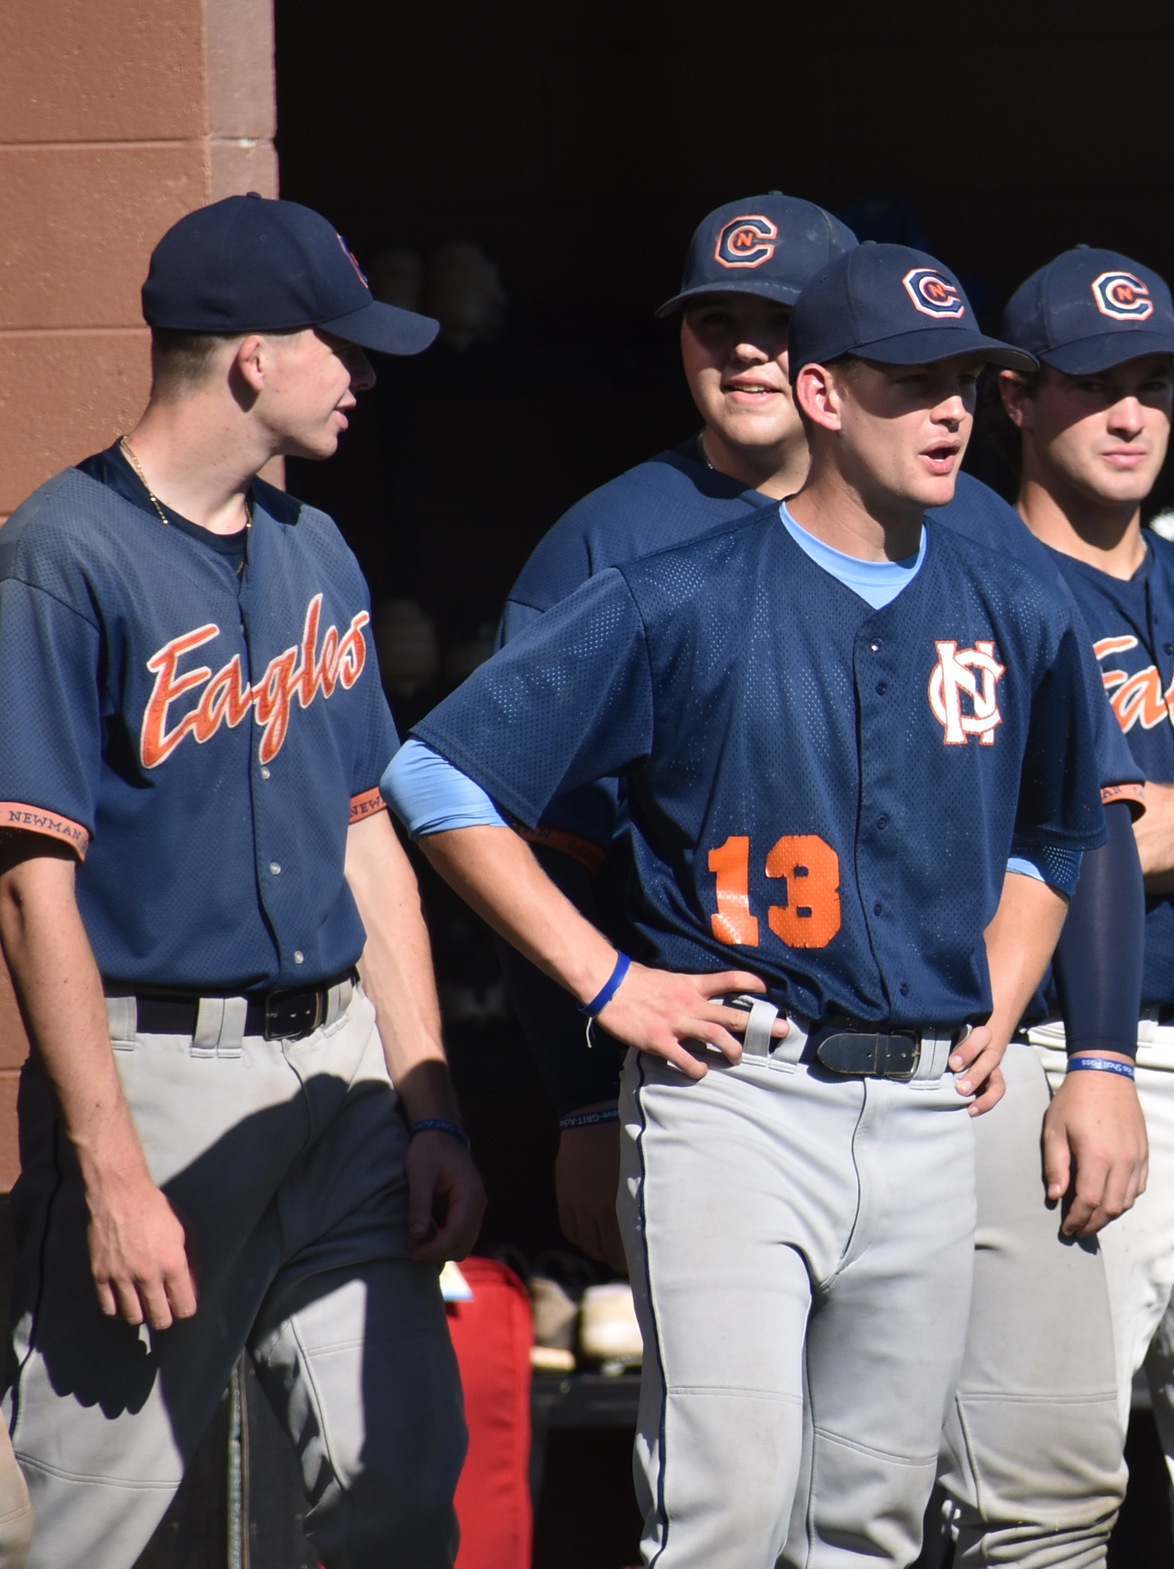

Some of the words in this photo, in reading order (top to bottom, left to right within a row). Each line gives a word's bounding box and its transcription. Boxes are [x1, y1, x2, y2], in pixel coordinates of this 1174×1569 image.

[140, 592, 370, 770] Eagles
[8, 810, 82, 841] NEWMAN
[350, 796, 386, 818] NEW
[708, 834, 842, 949] 13
